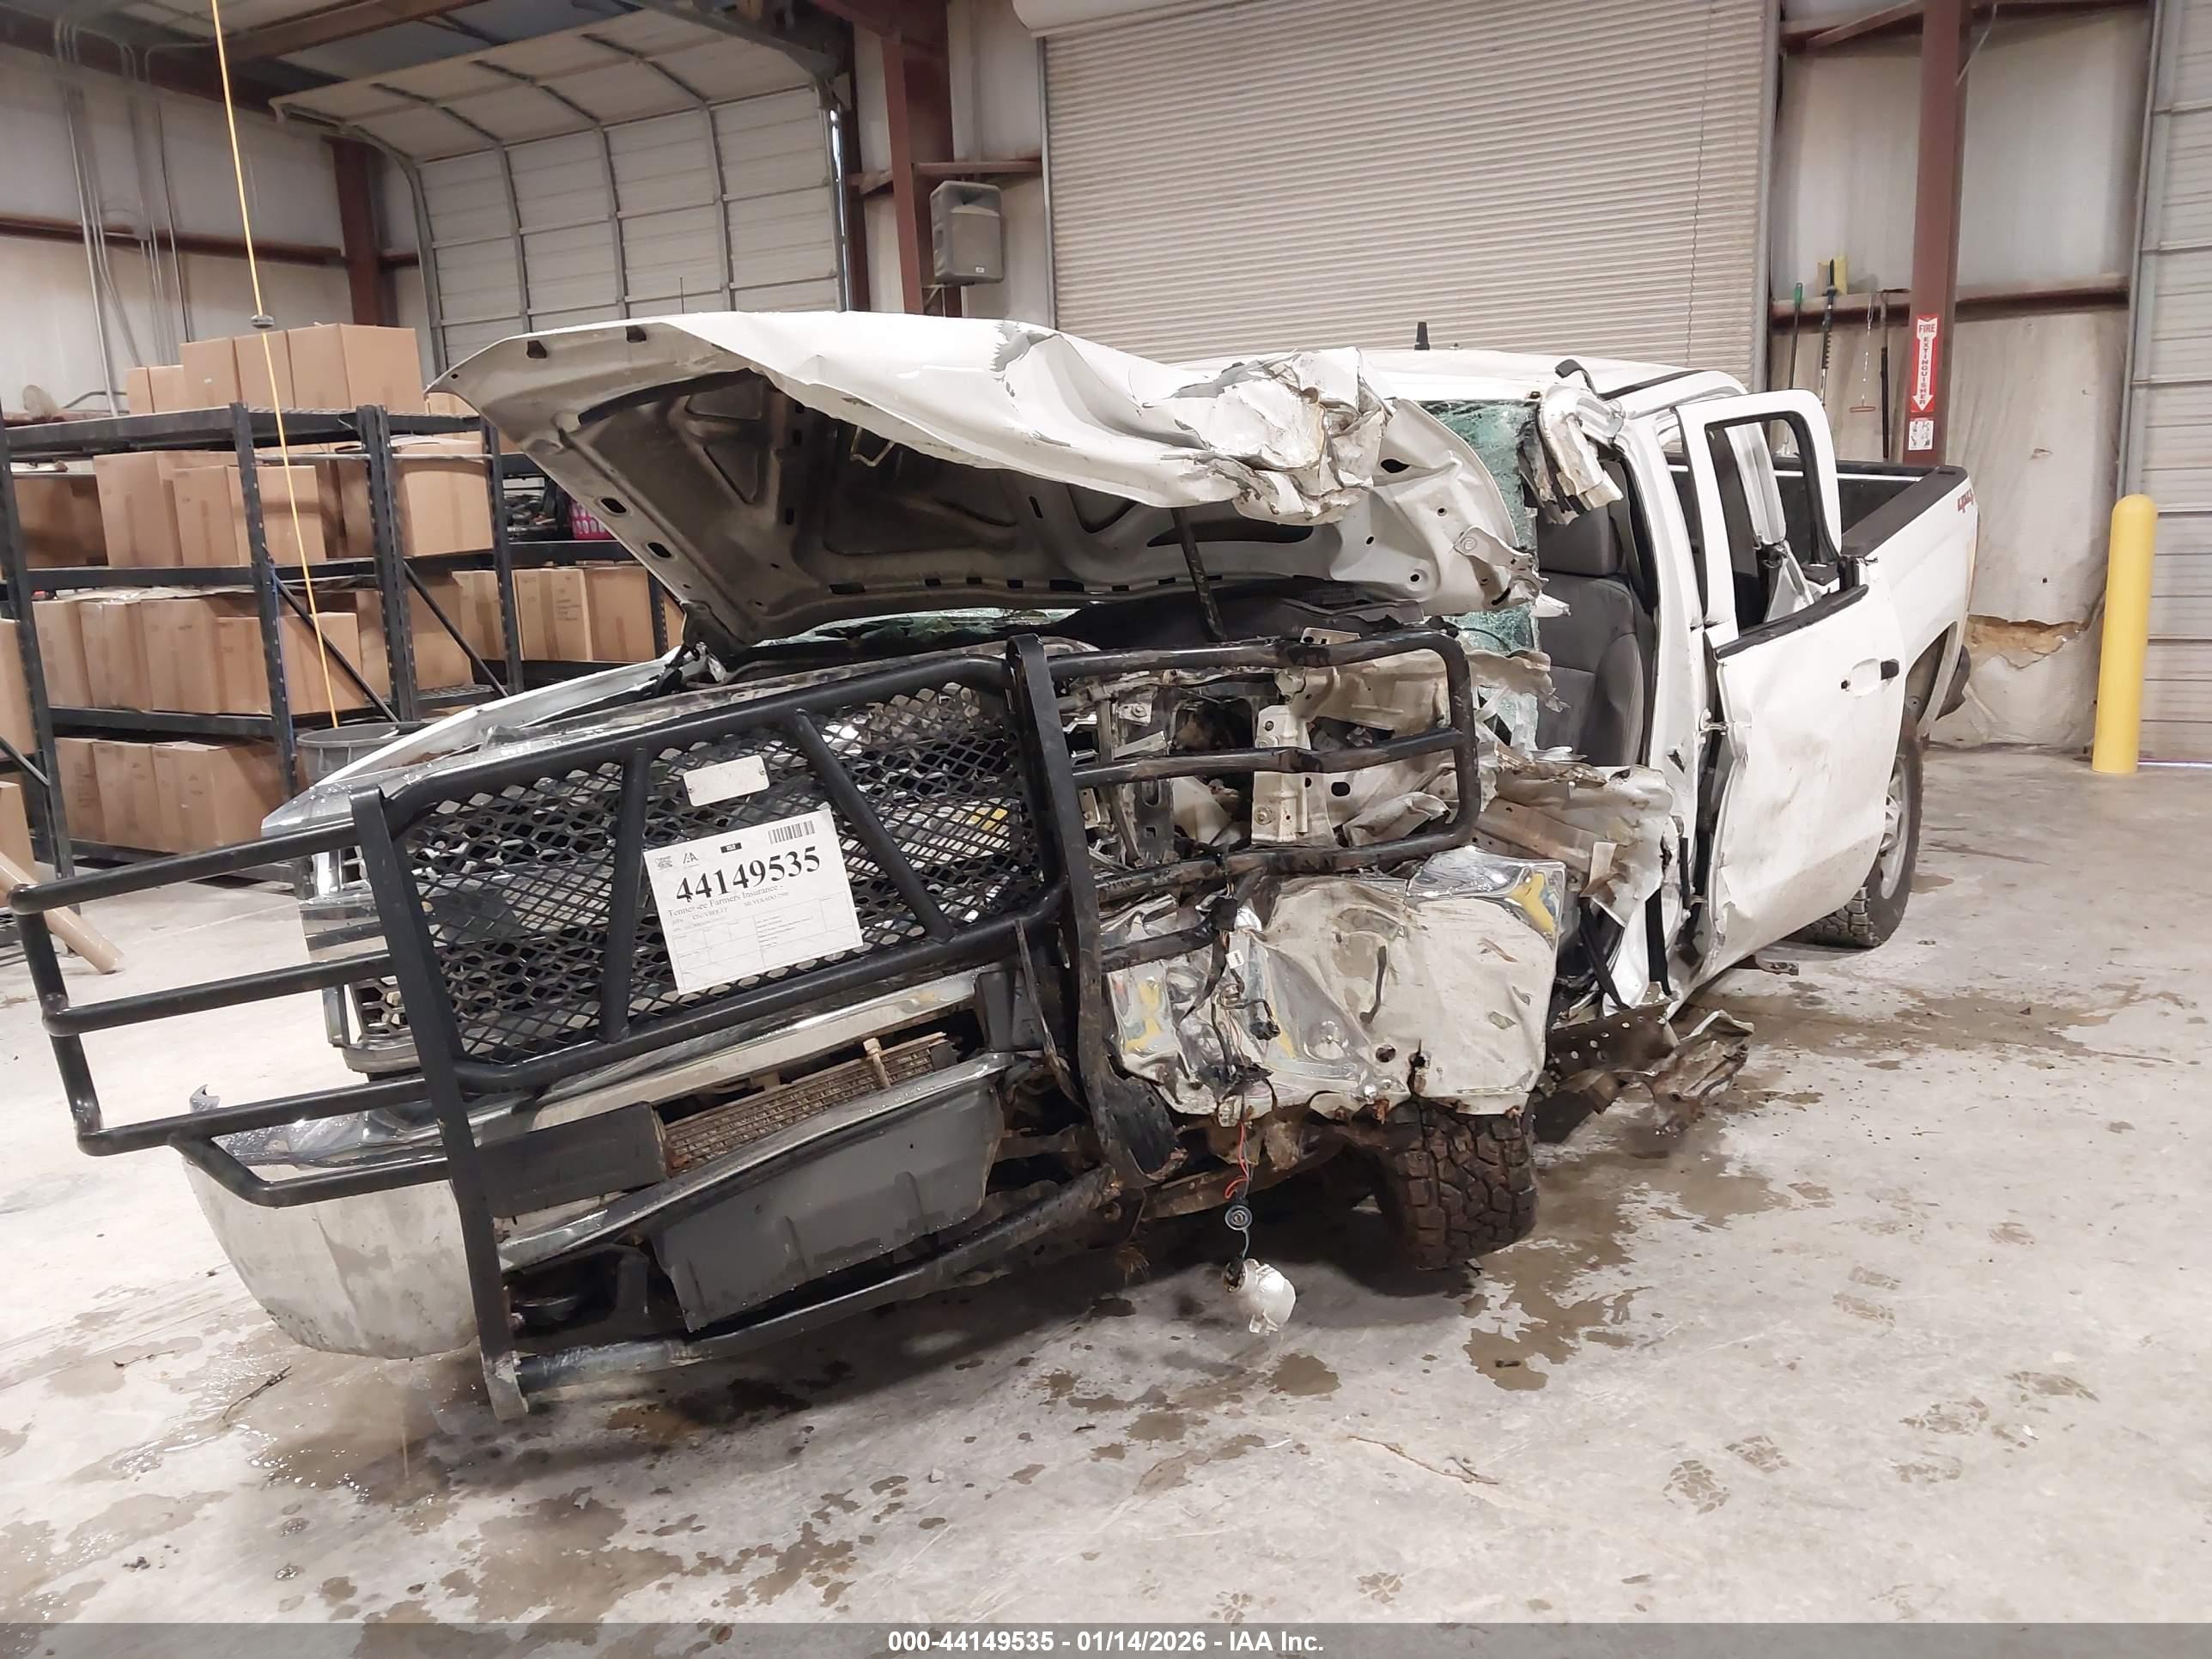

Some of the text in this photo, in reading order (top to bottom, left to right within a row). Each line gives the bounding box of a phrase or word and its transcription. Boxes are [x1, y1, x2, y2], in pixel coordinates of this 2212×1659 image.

[1918, 323, 1936, 333] FIRE
[1920, 336, 1929, 404] EXTINGUISHER
[676, 845, 820, 903] 44149535
[667, 902, 708, 918] Tennessee
[709, 896, 741, 908] Farmers
[742, 885, 778, 899] Insurance
